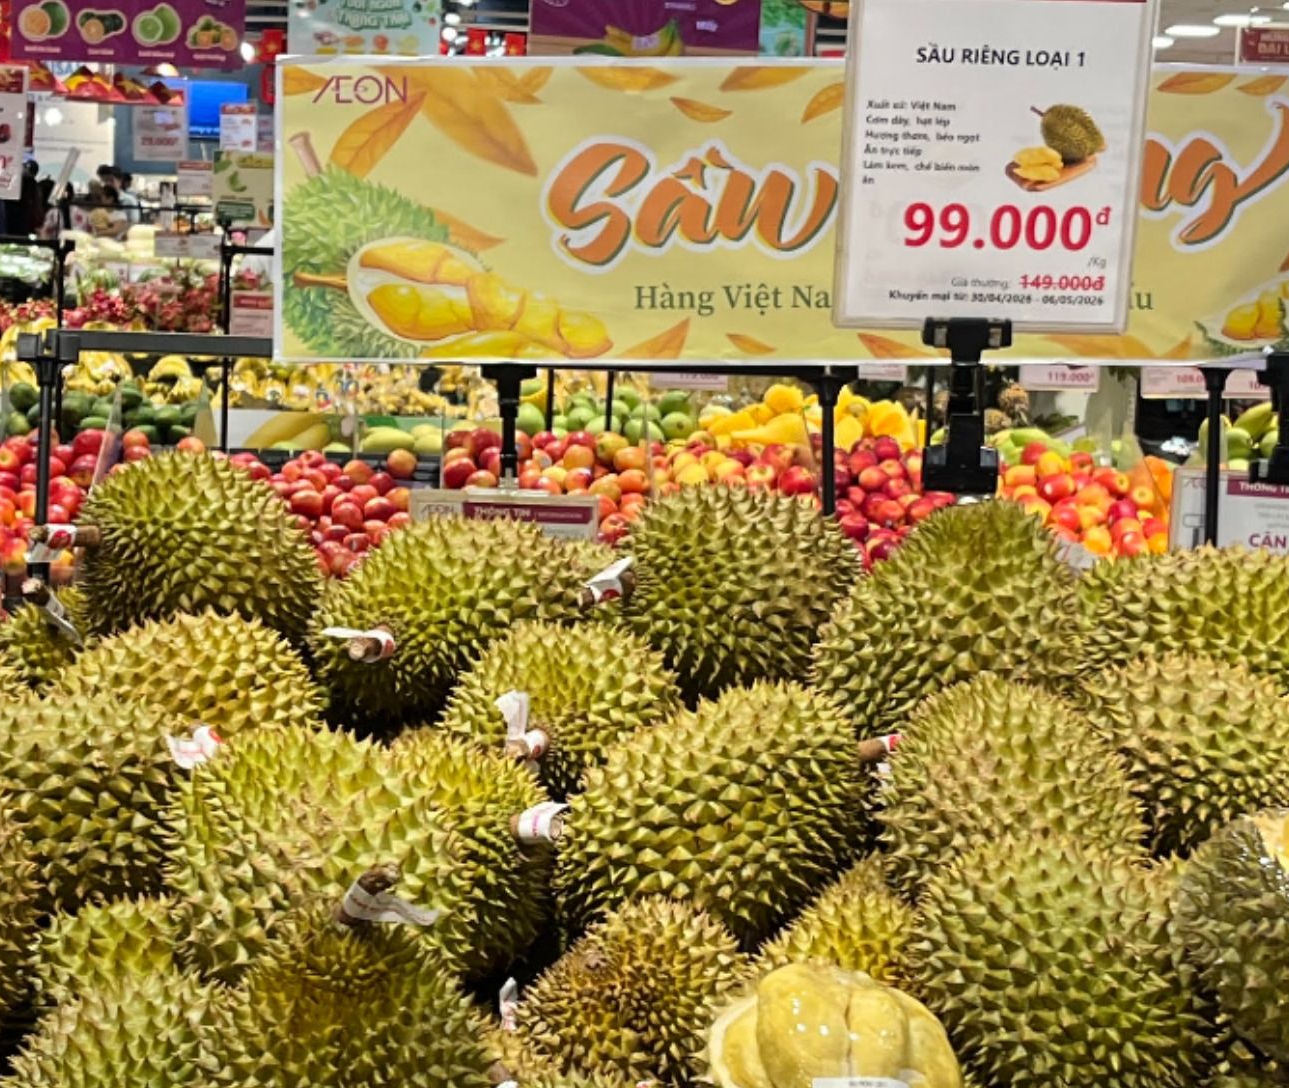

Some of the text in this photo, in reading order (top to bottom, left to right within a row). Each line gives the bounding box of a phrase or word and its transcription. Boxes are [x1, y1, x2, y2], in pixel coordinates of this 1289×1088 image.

[916, 41, 1086, 71] SẦU RIÊNG LOẠI 1
[911, 101, 930, 111] Việt
[933, 102, 956, 111] Nam
[904, 202, 1113, 251] 99.000đ
[951, 276, 969, 287] Giá
[634, 283, 830, 316] Hàng Việt Na
